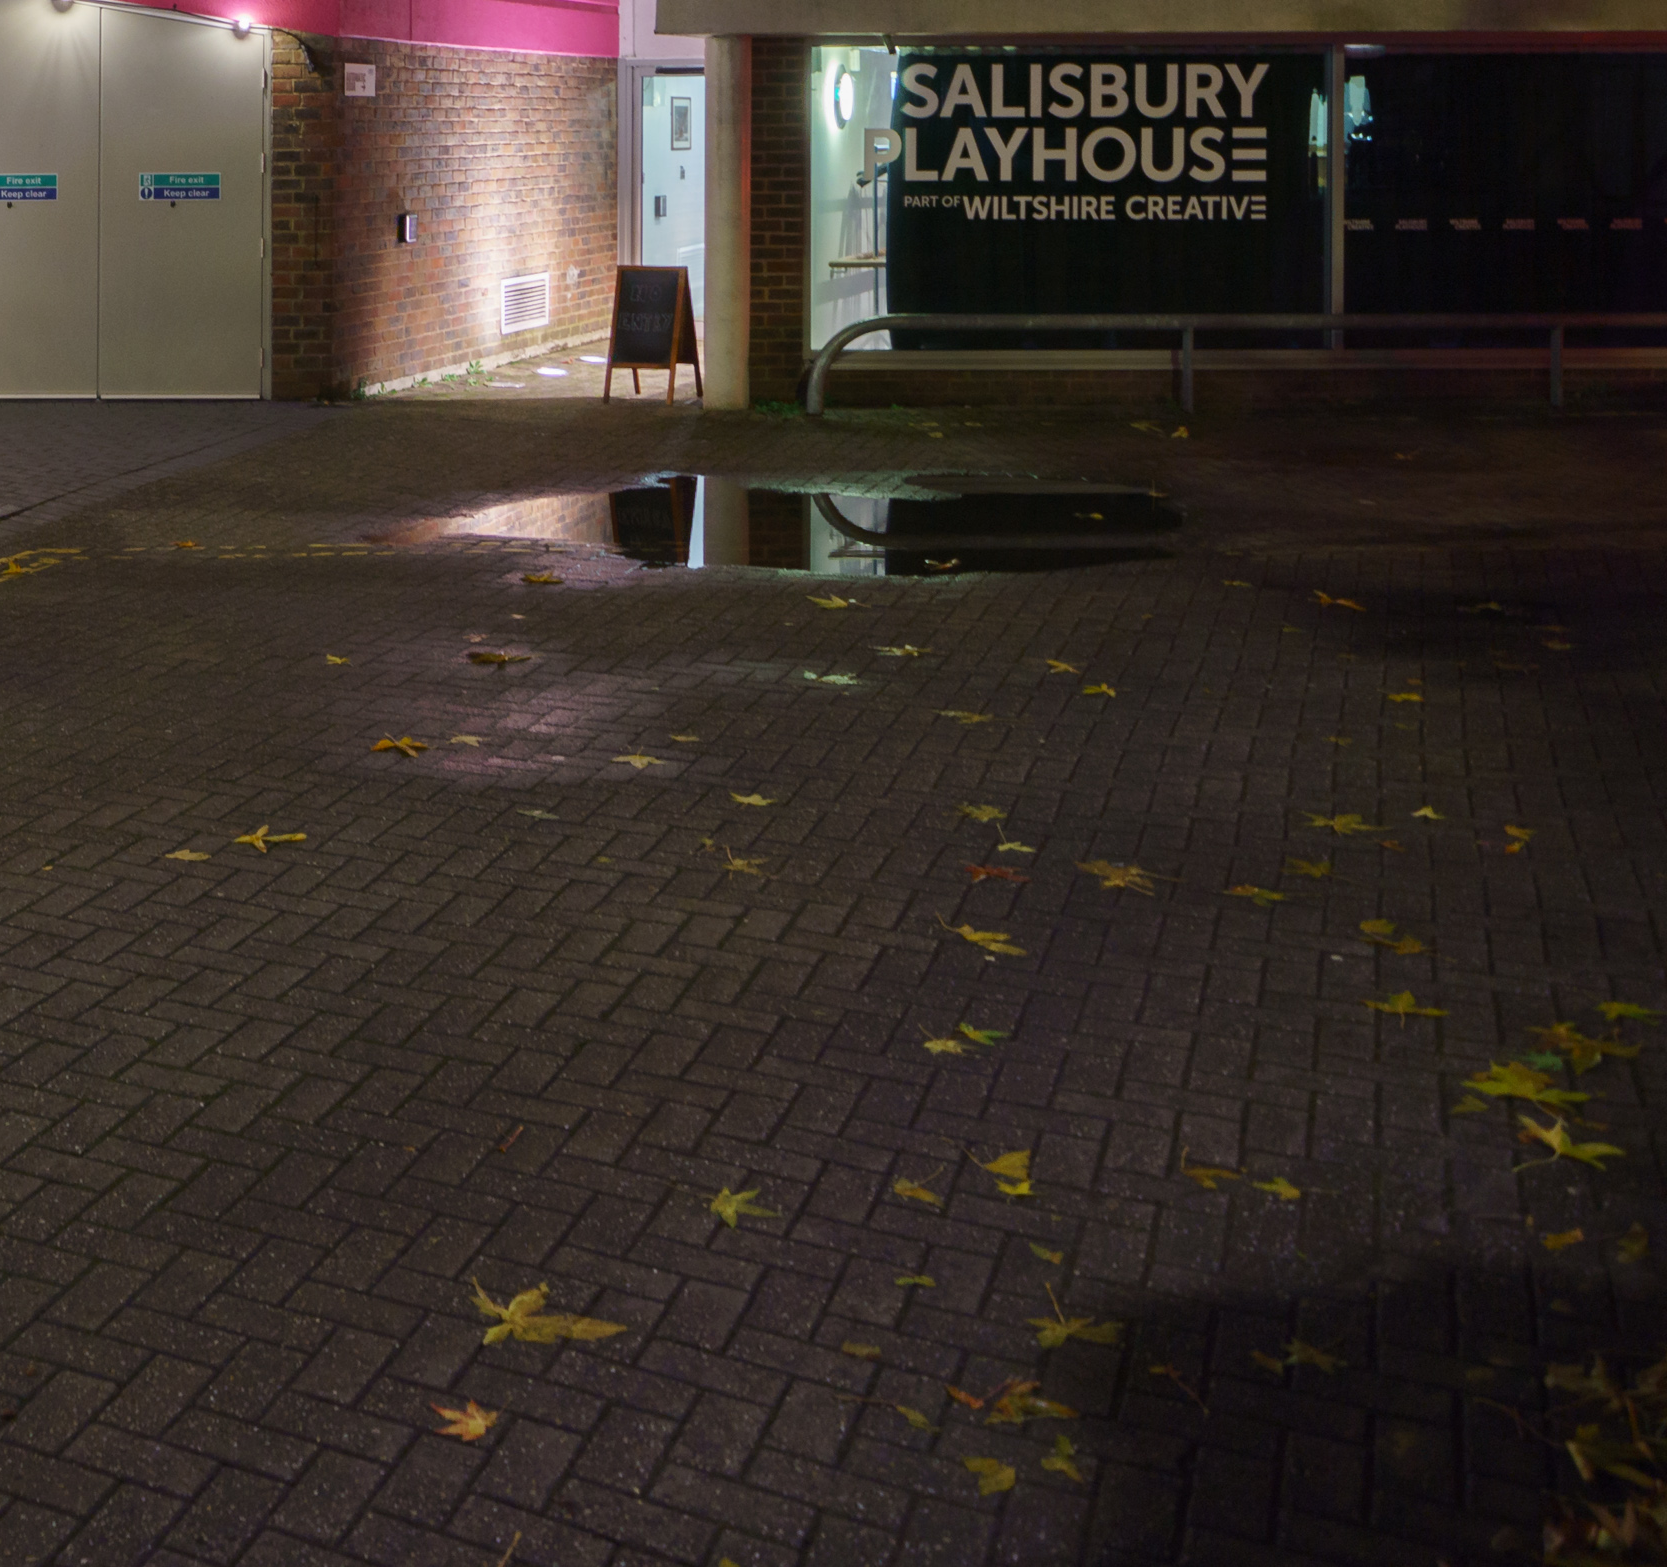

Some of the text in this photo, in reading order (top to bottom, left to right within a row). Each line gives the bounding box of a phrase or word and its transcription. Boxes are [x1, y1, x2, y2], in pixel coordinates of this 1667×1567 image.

[901, 63, 1269, 119] SALISBURY
[864, 127, 1267, 182] PLAYHOUSE
[6, 177, 42, 185] Fire exit
[169, 176, 204, 184] Fire exit
[0, 189, 47, 199] Keep clear
[164, 189, 210, 199] Keep clear
[904, 195, 1267, 221] PART OF WILTSHIRE CREATIVE
